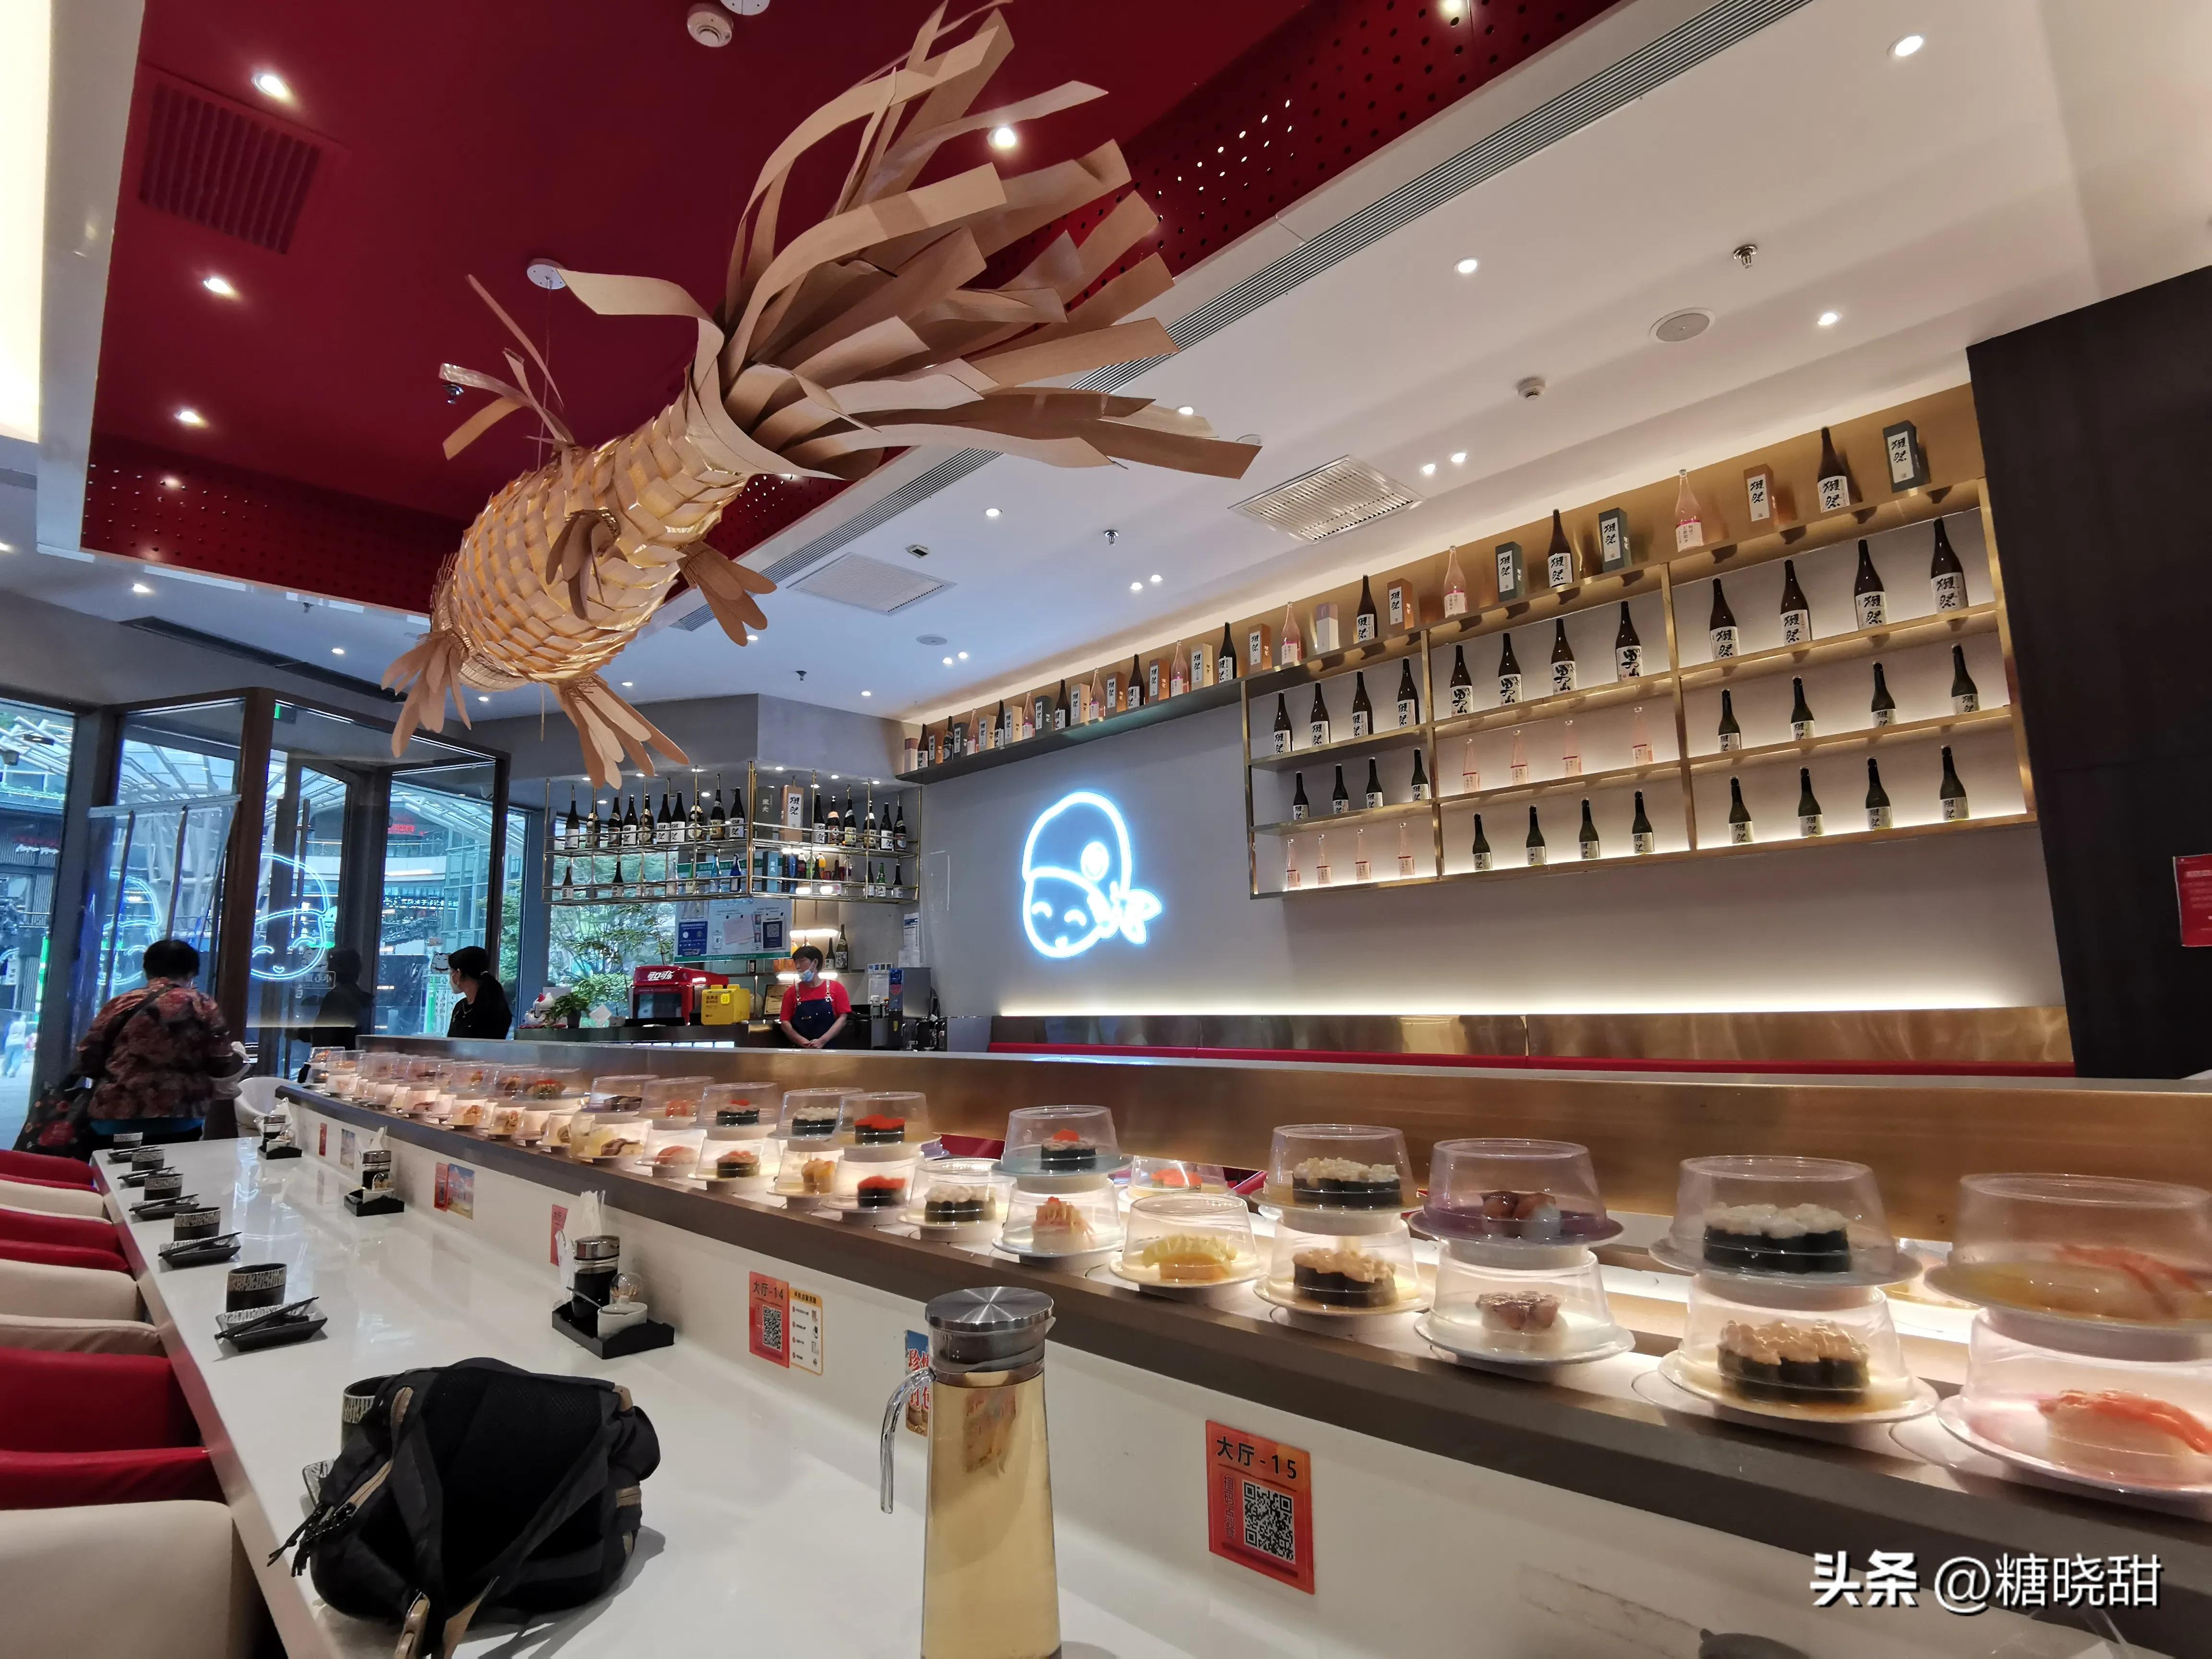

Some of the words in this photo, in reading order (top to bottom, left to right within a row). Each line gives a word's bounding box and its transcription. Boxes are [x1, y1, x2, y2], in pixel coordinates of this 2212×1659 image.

[1621, 649, 1639, 676] 男山
[1554, 664, 1572, 691] 男山
[1217, 1436, 1297, 1479] 大厅-15
